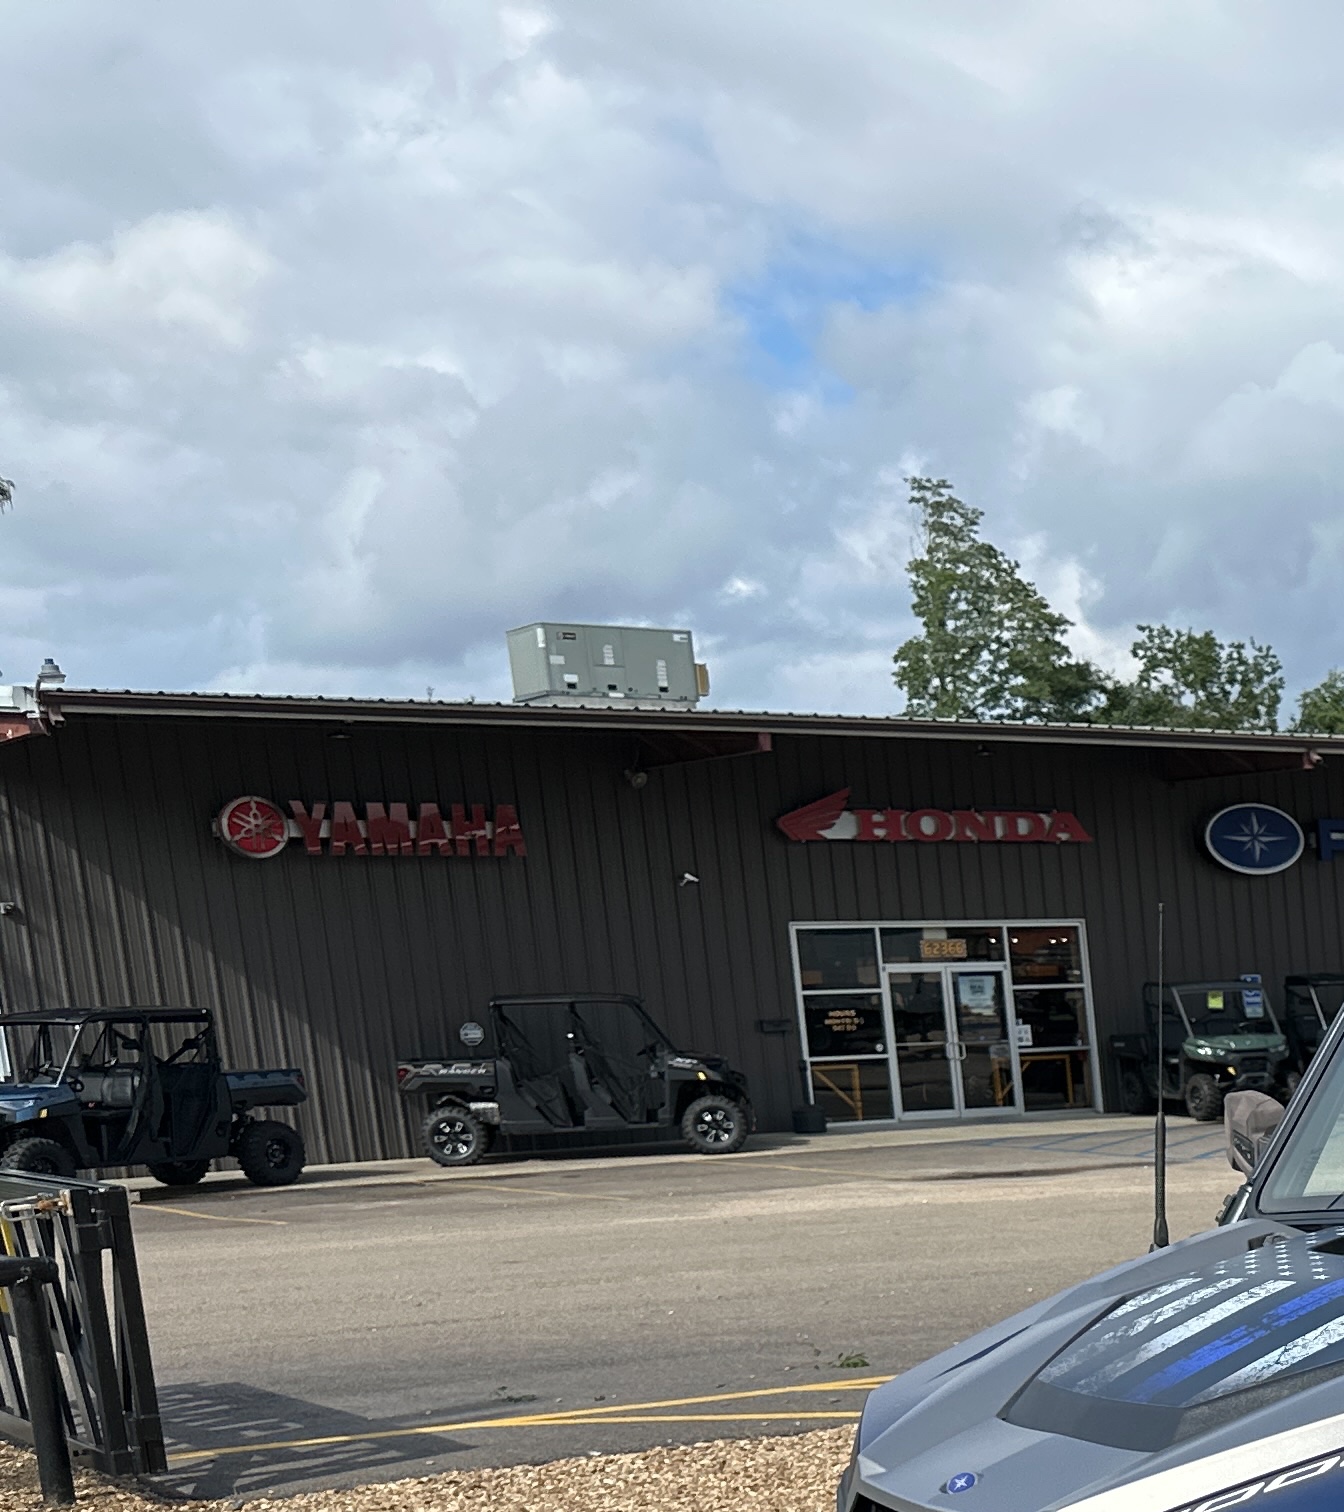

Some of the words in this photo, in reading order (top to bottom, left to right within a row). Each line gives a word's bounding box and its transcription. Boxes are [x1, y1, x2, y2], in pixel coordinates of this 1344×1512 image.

[288, 800, 527, 857] YAMAHA
[853, 808, 1093, 843] HONDA
[923, 941, 963, 955] 62366
